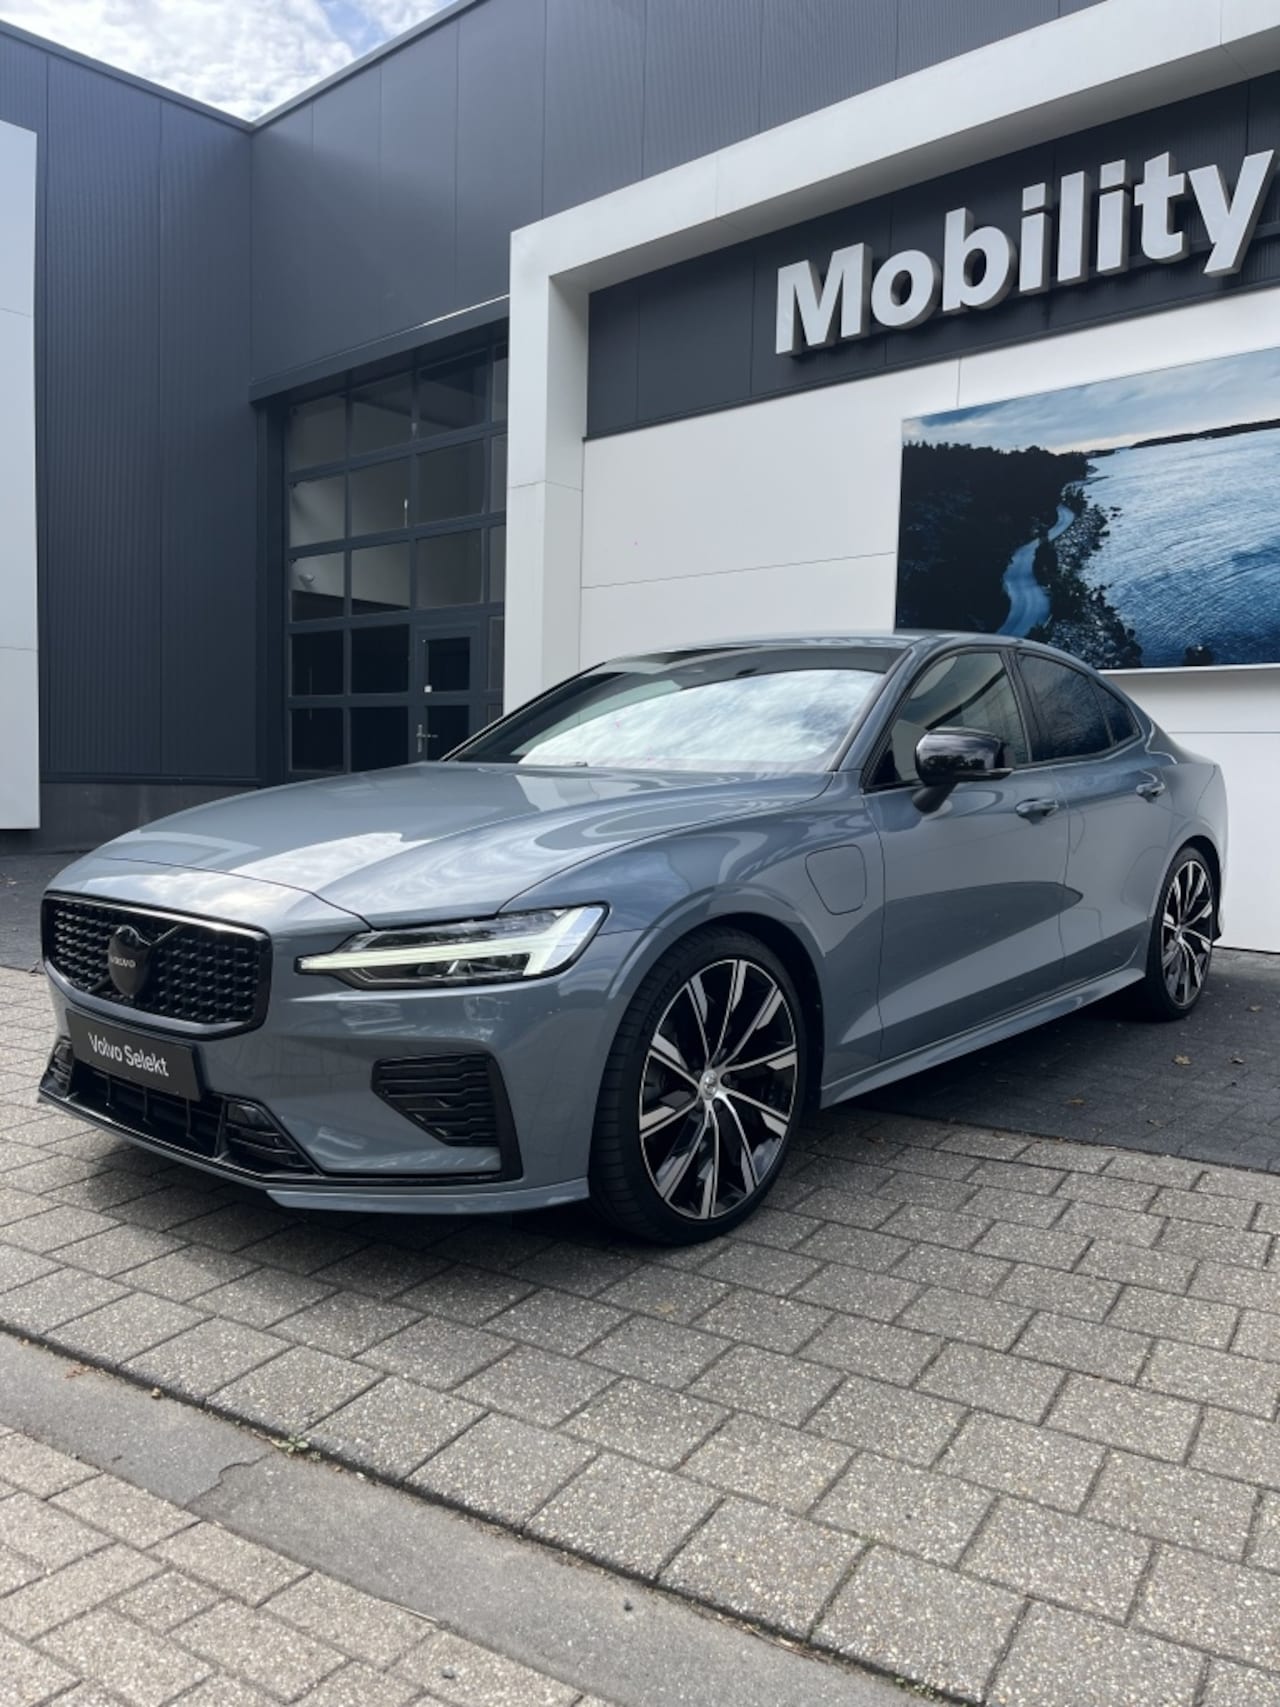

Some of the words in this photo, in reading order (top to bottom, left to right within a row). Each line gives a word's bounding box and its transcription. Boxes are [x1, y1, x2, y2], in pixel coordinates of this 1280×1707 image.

[775, 149, 1276, 355] Mobility
[88, 1032, 123, 1062] Volvo
[123, 1044, 170, 1077] Selekt
